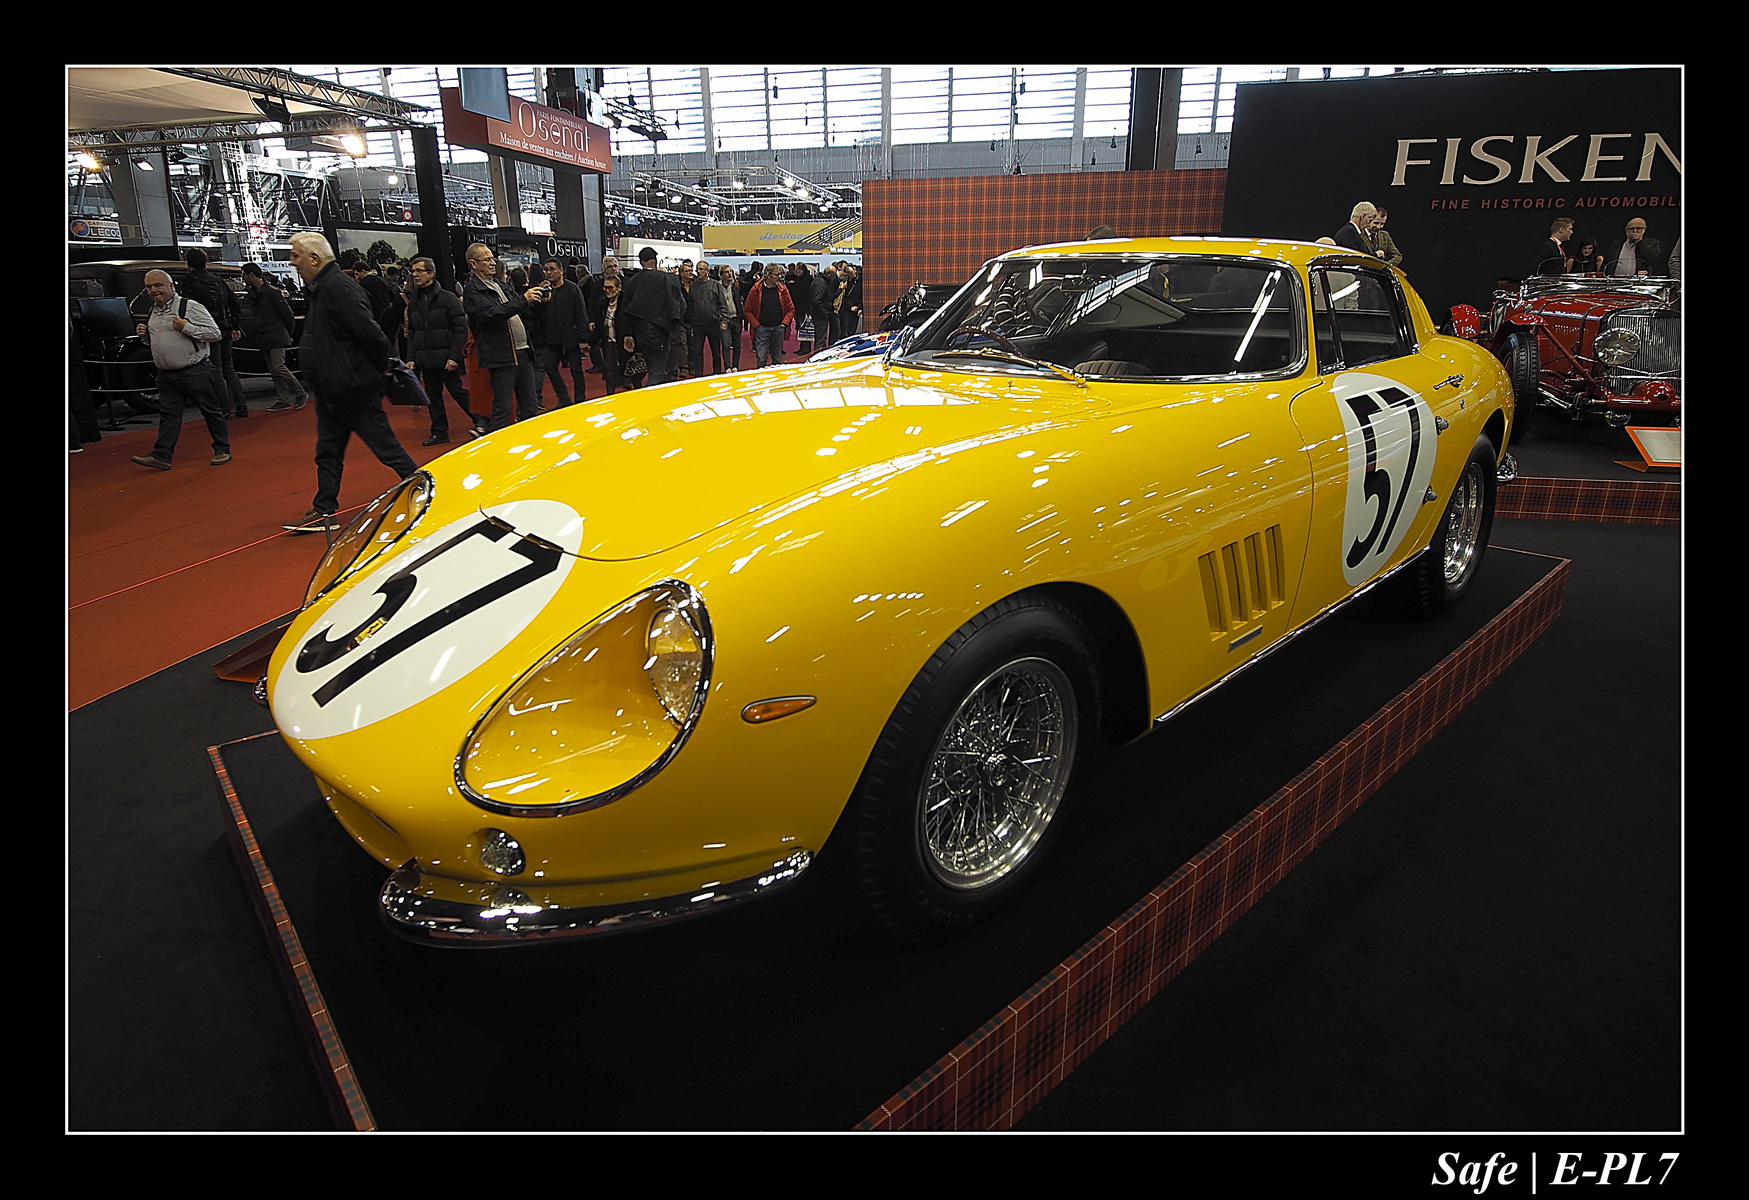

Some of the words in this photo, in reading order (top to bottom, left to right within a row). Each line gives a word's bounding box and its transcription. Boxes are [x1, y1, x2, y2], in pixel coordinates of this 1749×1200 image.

[518, 101, 591, 153] Osenat
[536, 109, 550, 120] PARIS
[550, 114, 584, 131] FONTAINEBLEAU
[499, 131, 521, 148] Maison
[521, 138, 529, 150] de
[529, 141, 545, 155] ventes
[545, 146, 555, 156] aux
[554, 149, 574, 162] enchères
[577, 153, 594, 166] Auction
[594, 158, 607, 170] house
[1430, 199, 1470, 210] FINE
[1480, 197, 1567, 209] HISTORIC
[1574, 195, 1681, 208] AUTOMOBIL
[1345, 386, 1421, 569] 57
[295, 514, 566, 709] 57
